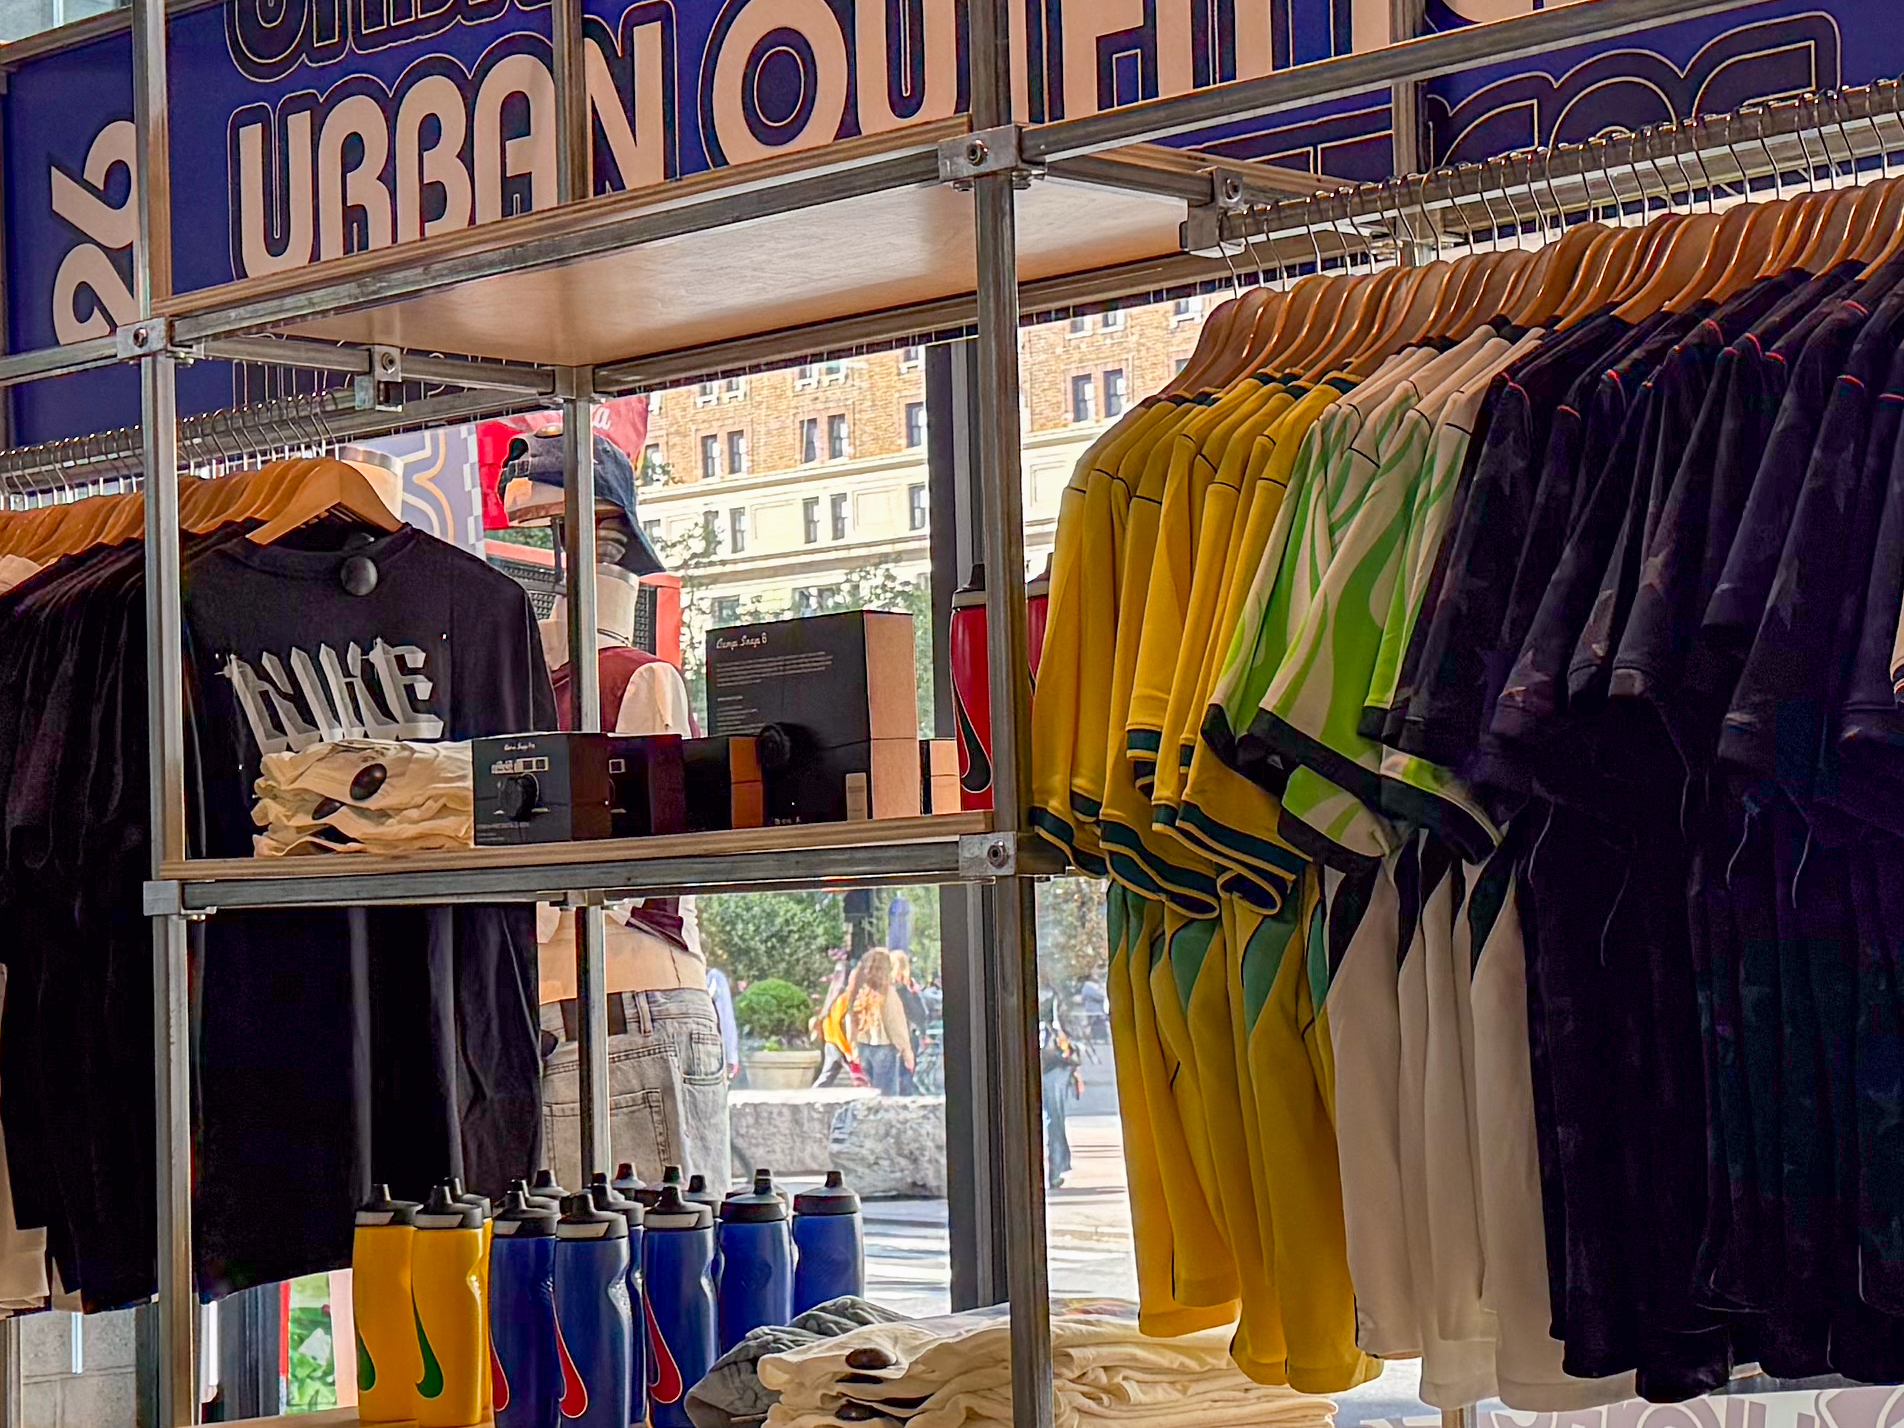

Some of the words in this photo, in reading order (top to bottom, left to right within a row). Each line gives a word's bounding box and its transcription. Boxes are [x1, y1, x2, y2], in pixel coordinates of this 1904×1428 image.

[50, 118, 140, 348] 26
[237, 21, 666, 278] URBAN
[214, 637, 445, 758] NIKE
